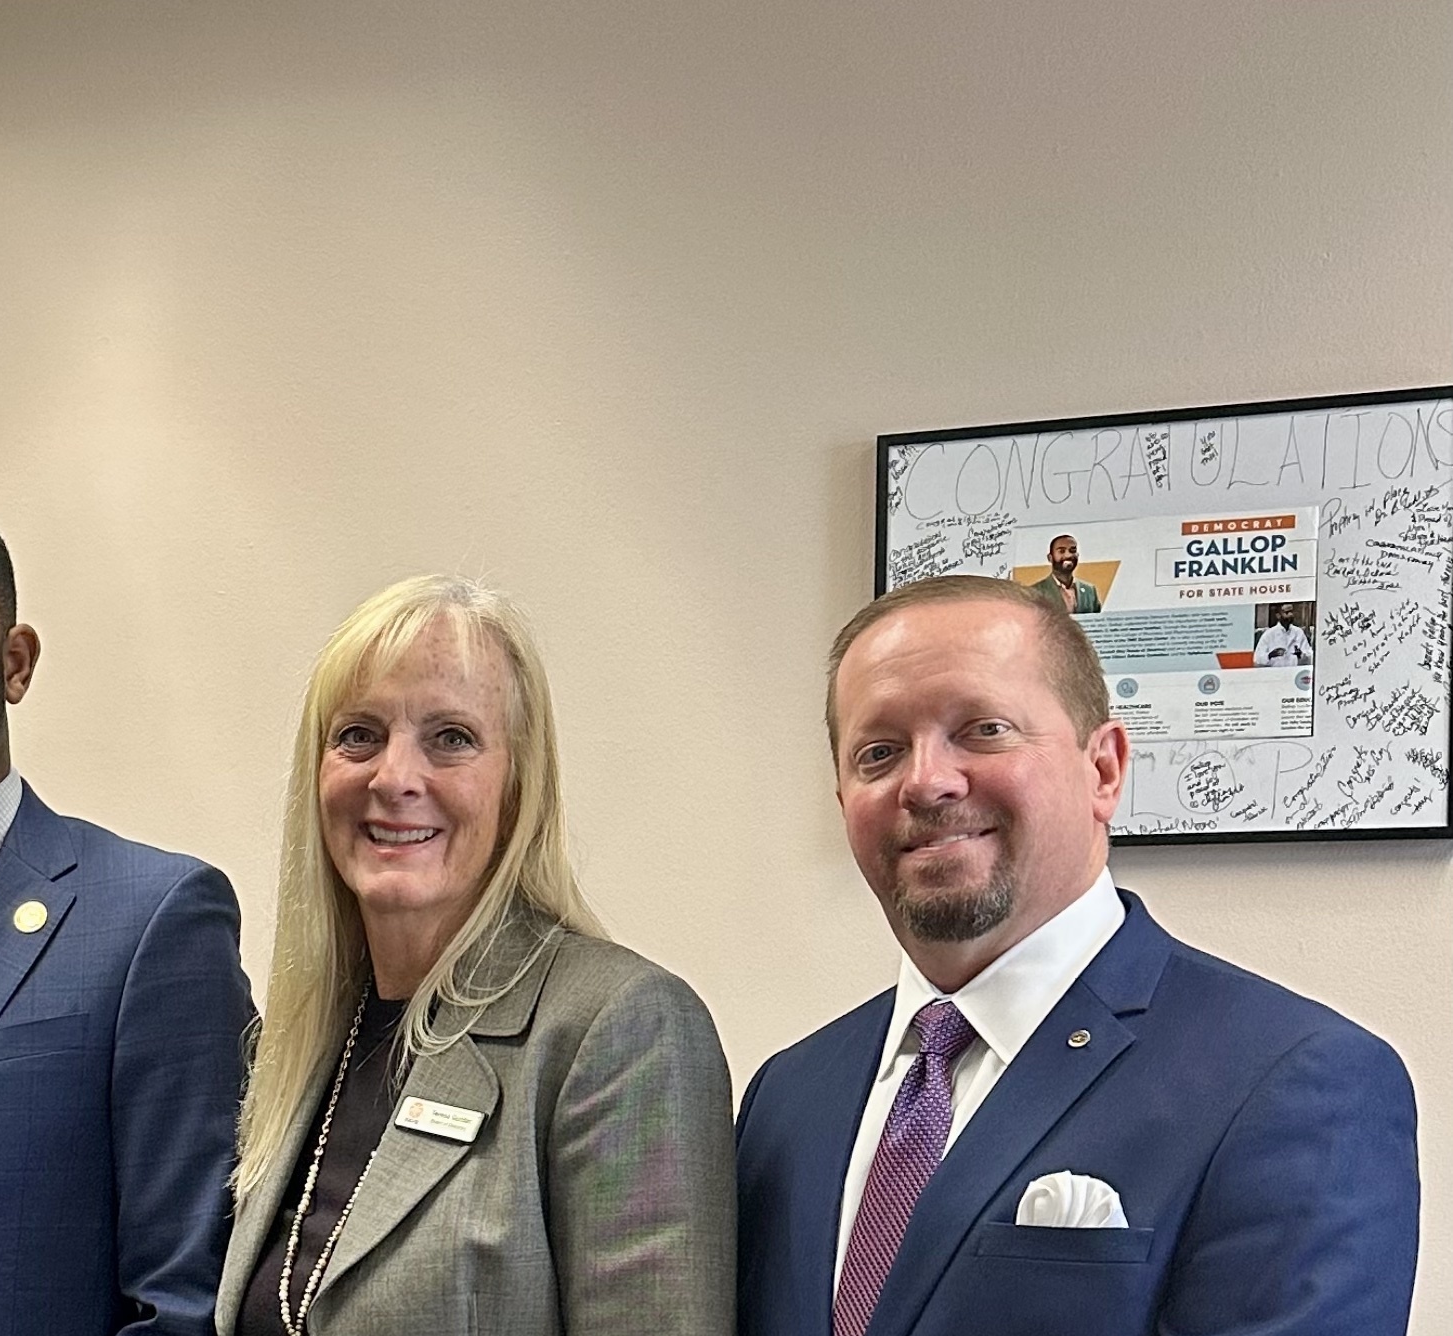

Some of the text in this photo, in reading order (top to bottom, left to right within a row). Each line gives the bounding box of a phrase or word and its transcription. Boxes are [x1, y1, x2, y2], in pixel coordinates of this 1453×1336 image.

[1190, 518, 1284, 533] DEMOCRAT
[1185, 534, 1287, 557] GALLOP
[1173, 554, 1298, 579] FRANKLIN
[1179, 584, 1292, 599] FOR STATE HOUSE
